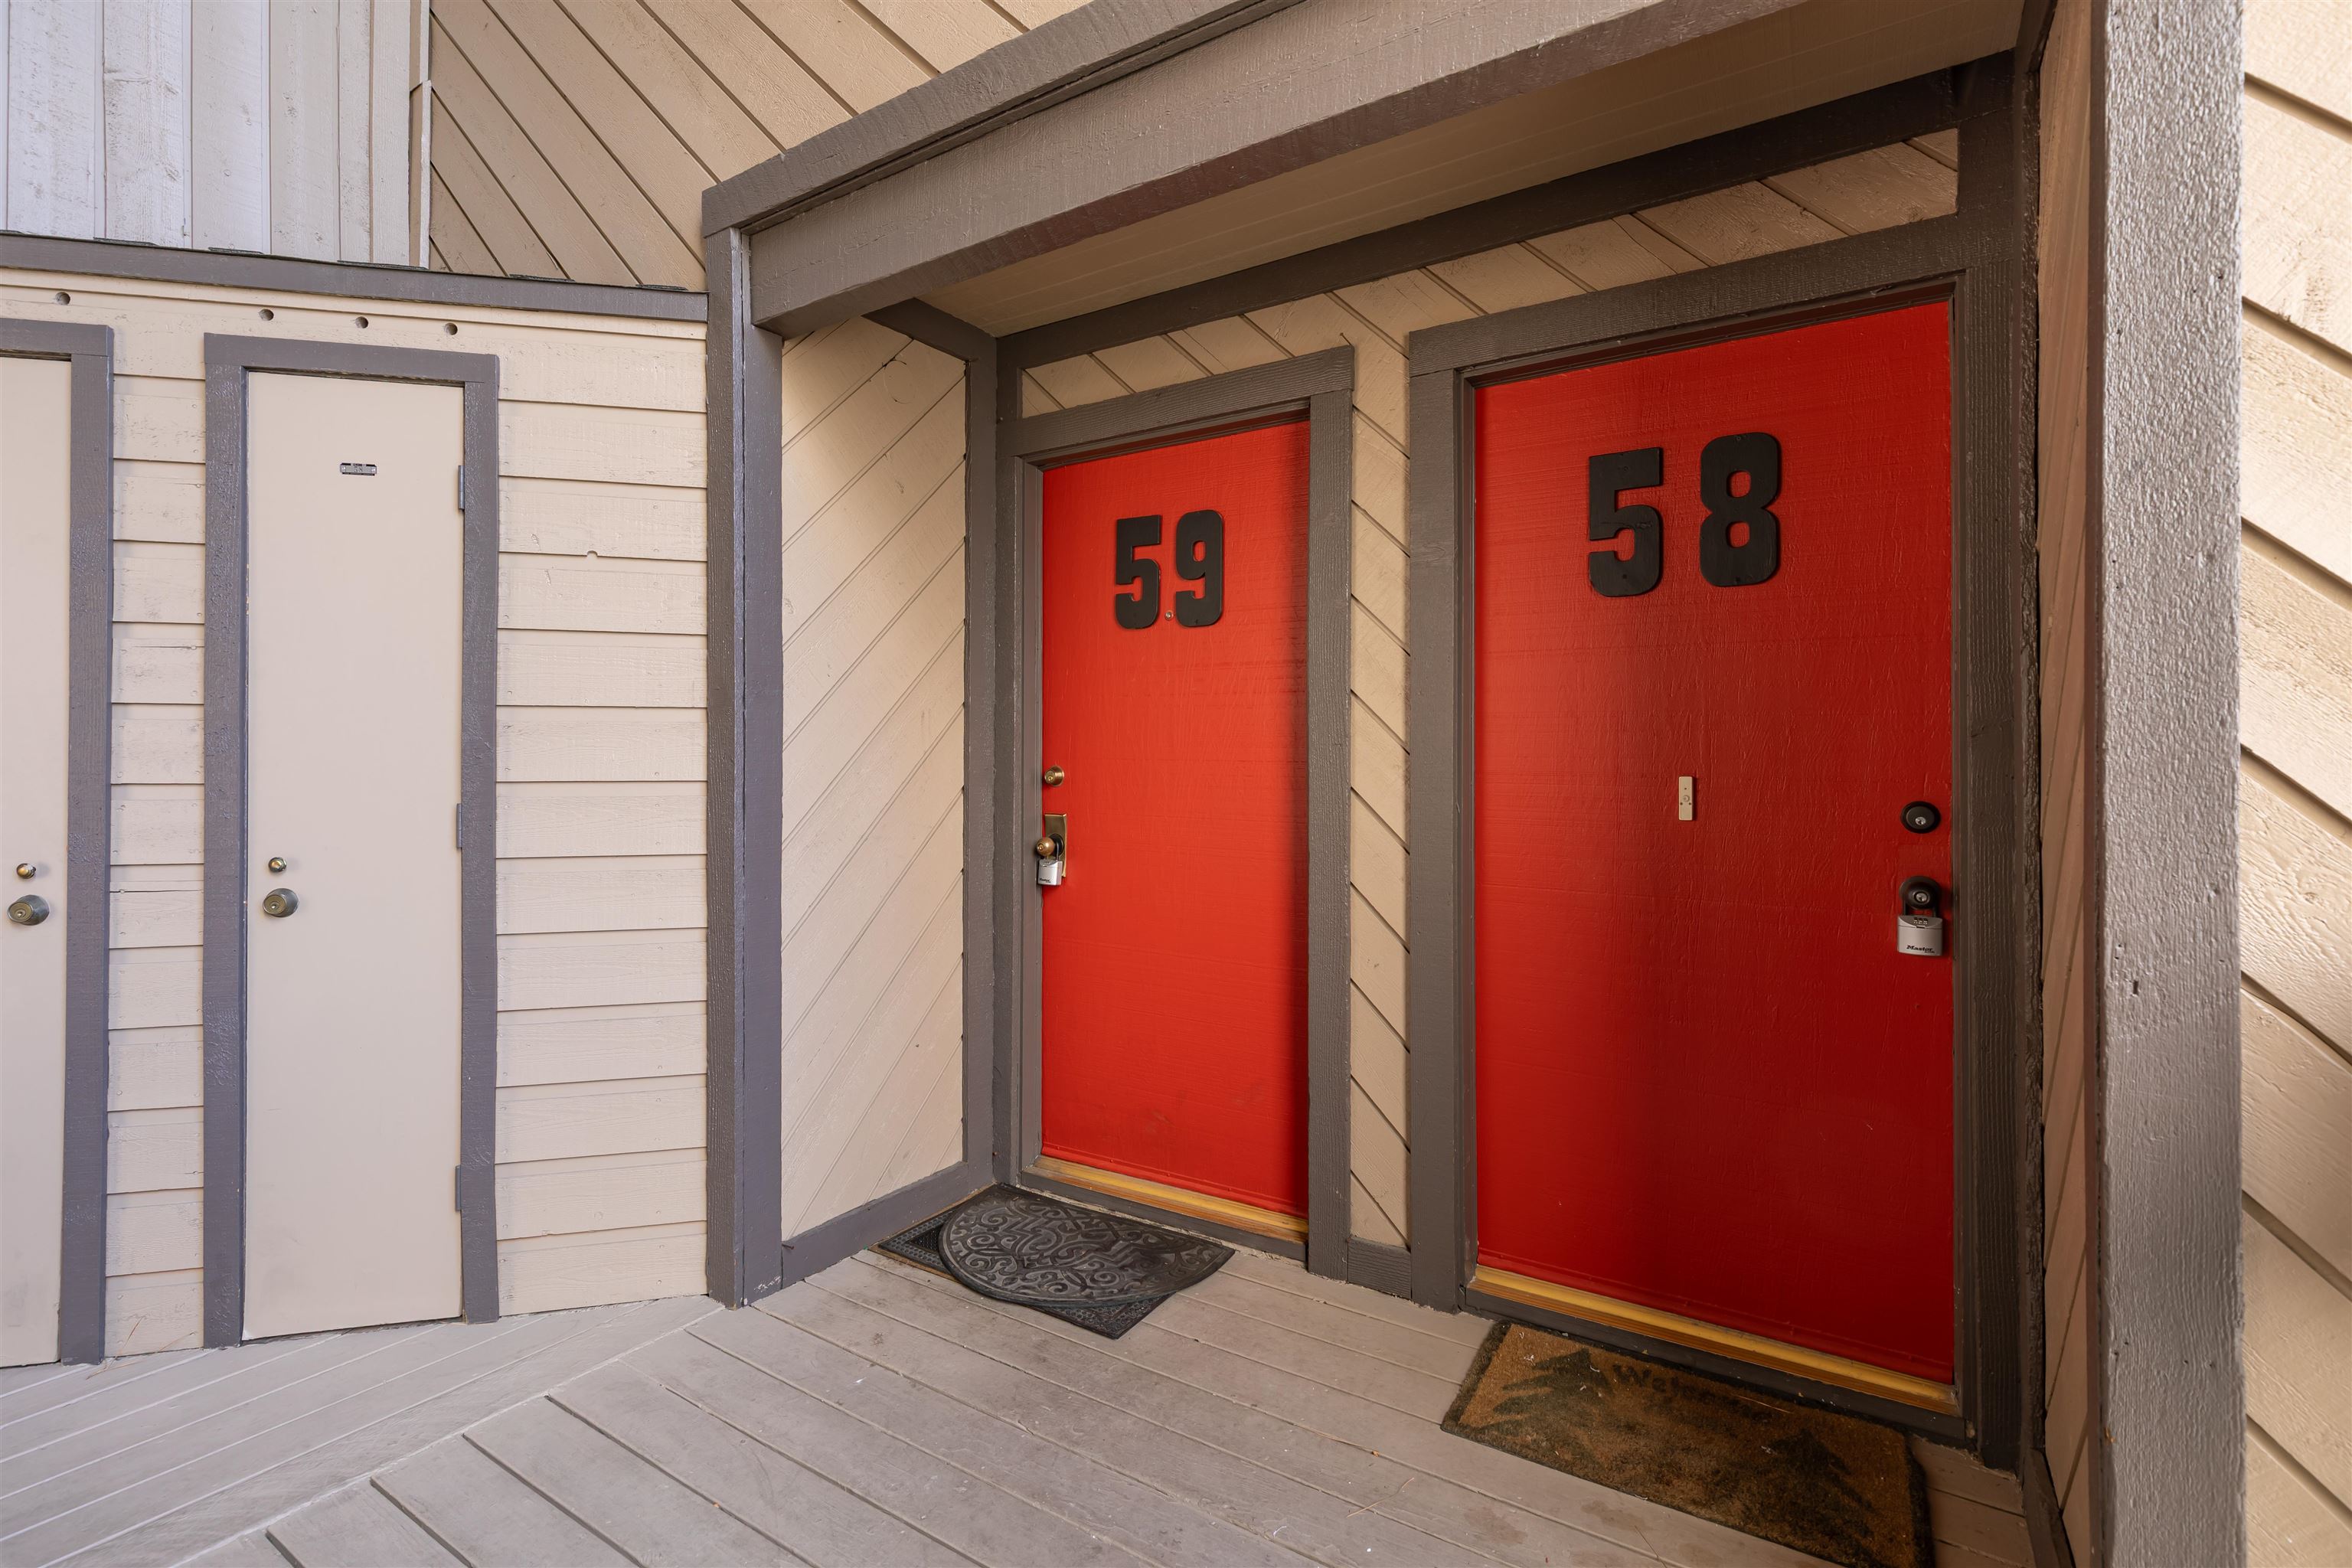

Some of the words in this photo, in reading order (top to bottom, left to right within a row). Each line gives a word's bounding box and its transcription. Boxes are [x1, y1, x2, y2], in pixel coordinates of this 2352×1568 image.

[1116, 509, 1223, 629] 59
[1589, 432, 1780, 597] 58
[1612, 1364, 1774, 1426] Wele
